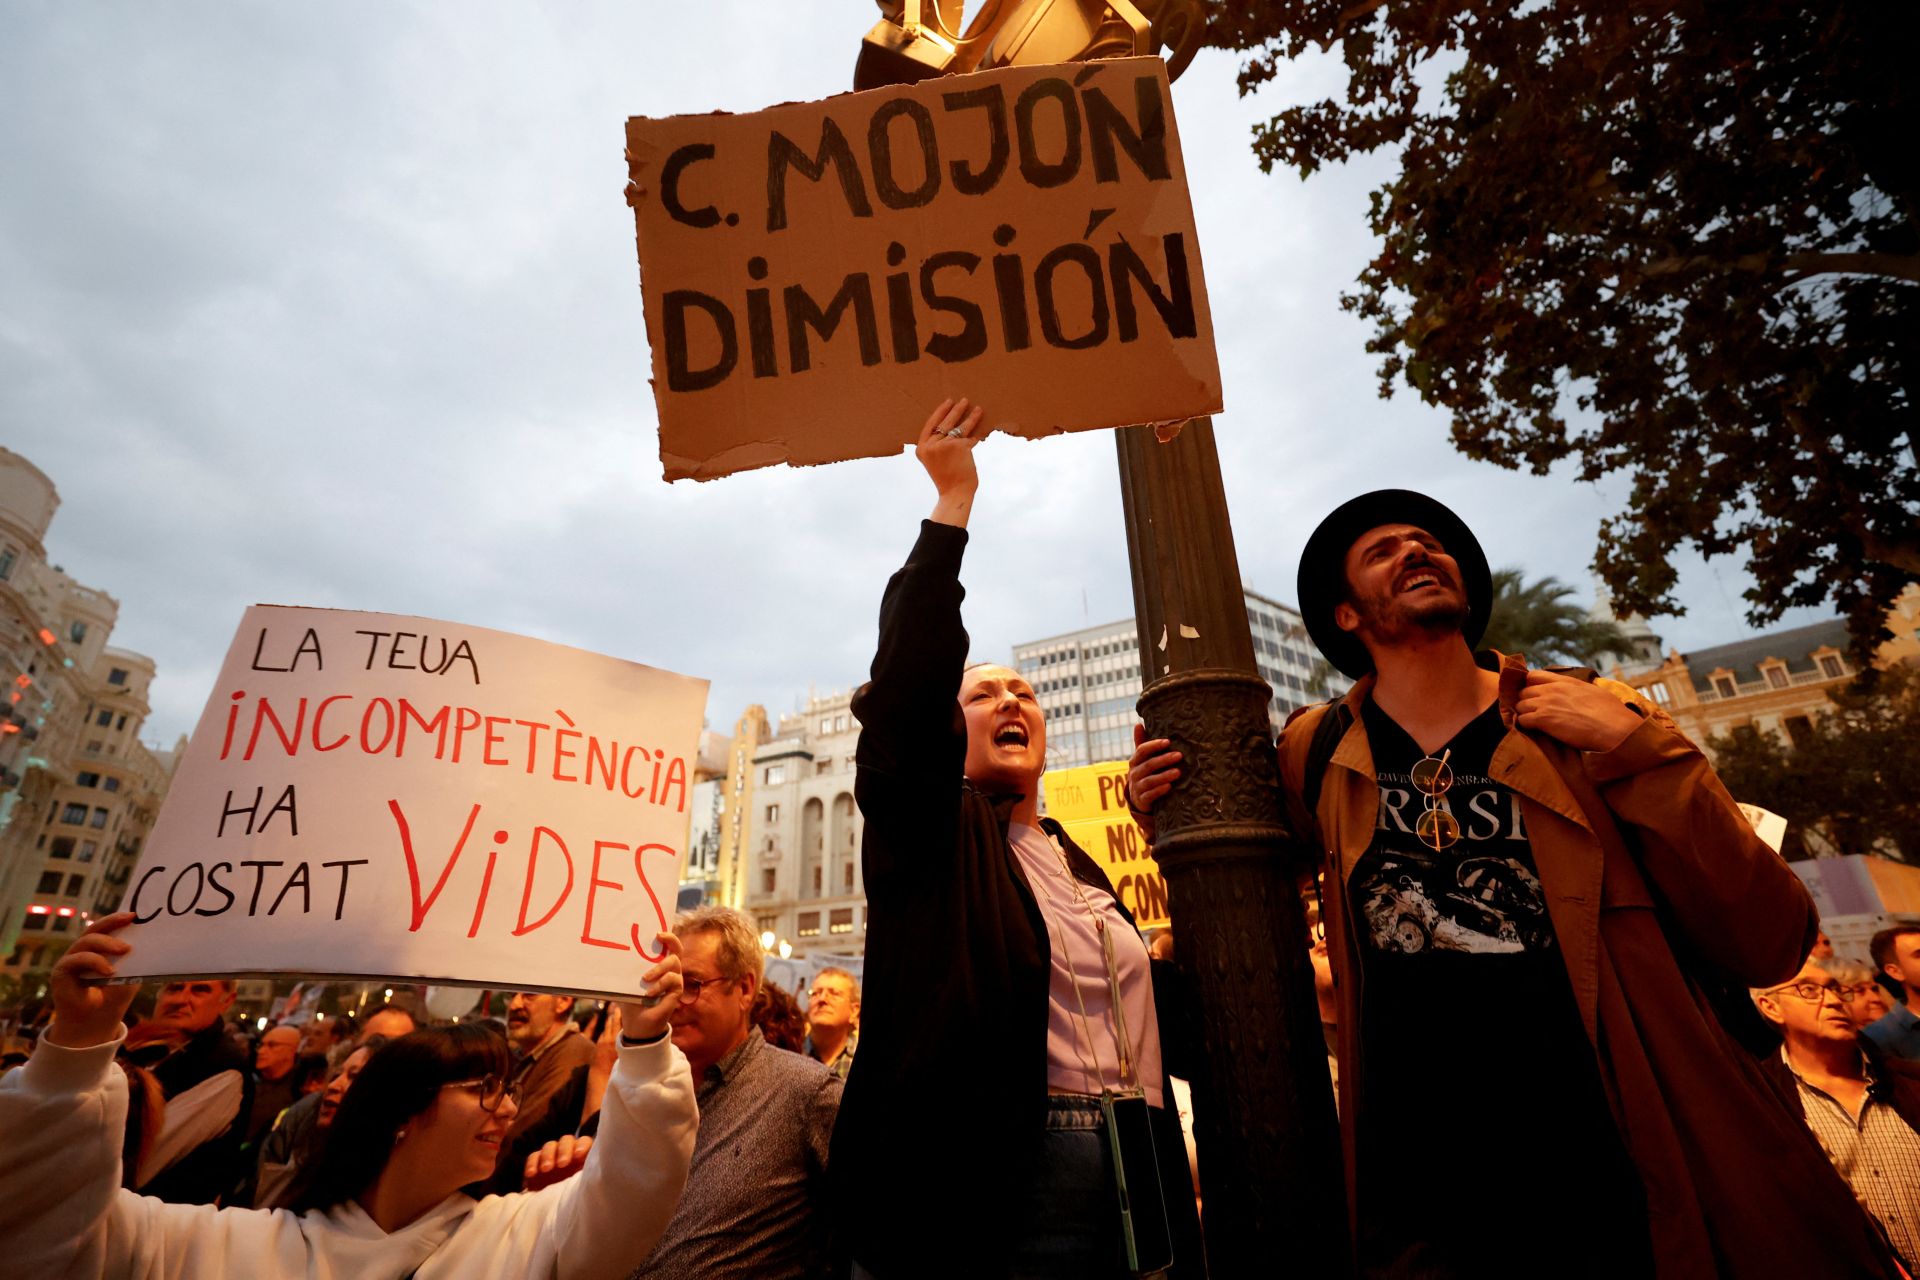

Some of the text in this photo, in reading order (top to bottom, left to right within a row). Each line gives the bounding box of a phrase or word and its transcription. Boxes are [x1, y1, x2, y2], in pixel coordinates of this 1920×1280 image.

[659, 64, 1173, 233] C. MOJÓN
[251, 627, 482, 685] LA TEUA
[1054, 785, 1085, 808] TOTA
[1377, 772, 1411, 784] DAVID
[217, 784, 299, 838] HA
[130, 859, 370, 924] COSTAT
